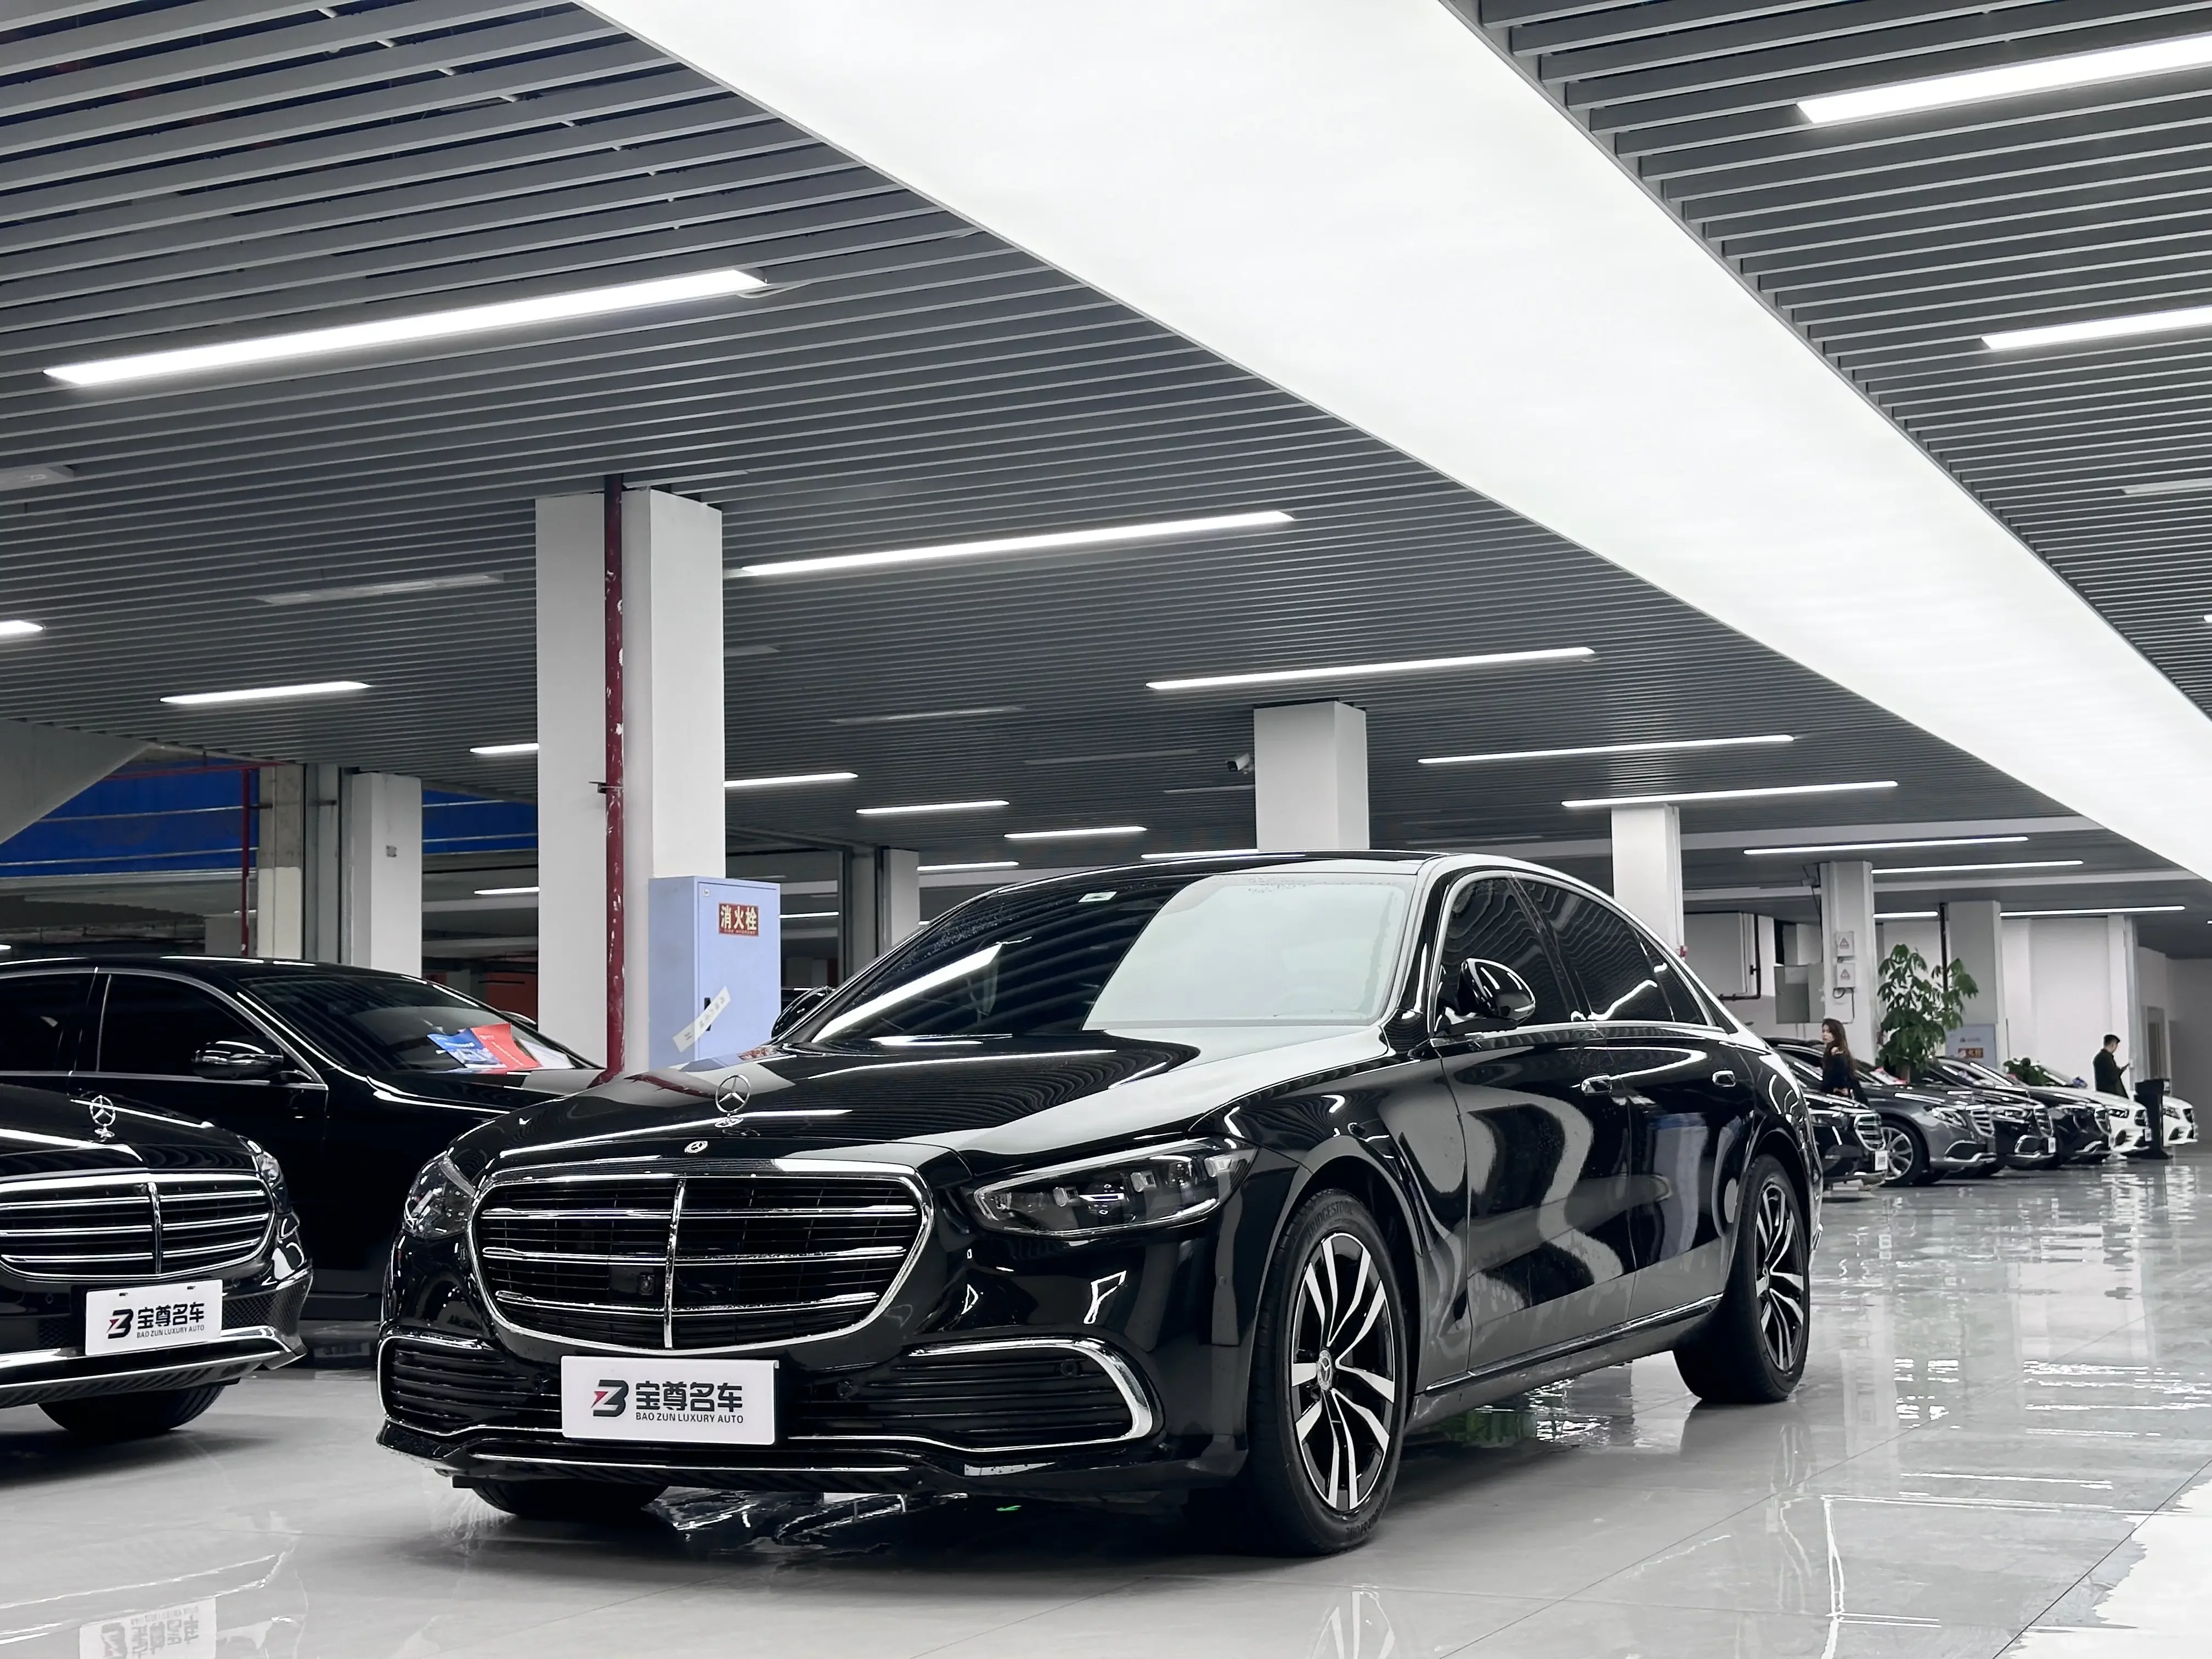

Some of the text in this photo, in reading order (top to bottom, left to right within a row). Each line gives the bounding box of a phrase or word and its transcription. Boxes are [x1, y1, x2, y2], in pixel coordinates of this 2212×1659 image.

[720, 905, 757, 931] 消火栓
[137, 1301, 205, 1330] 宝尊名车
[164, 1327, 187, 1335] LUXURY
[188, 1324, 205, 1333] AUTO
[635, 1380, 743, 1413] 宝尊名车
[636, 1412, 744, 1424] BAO ZUN LUXURY AUTO
